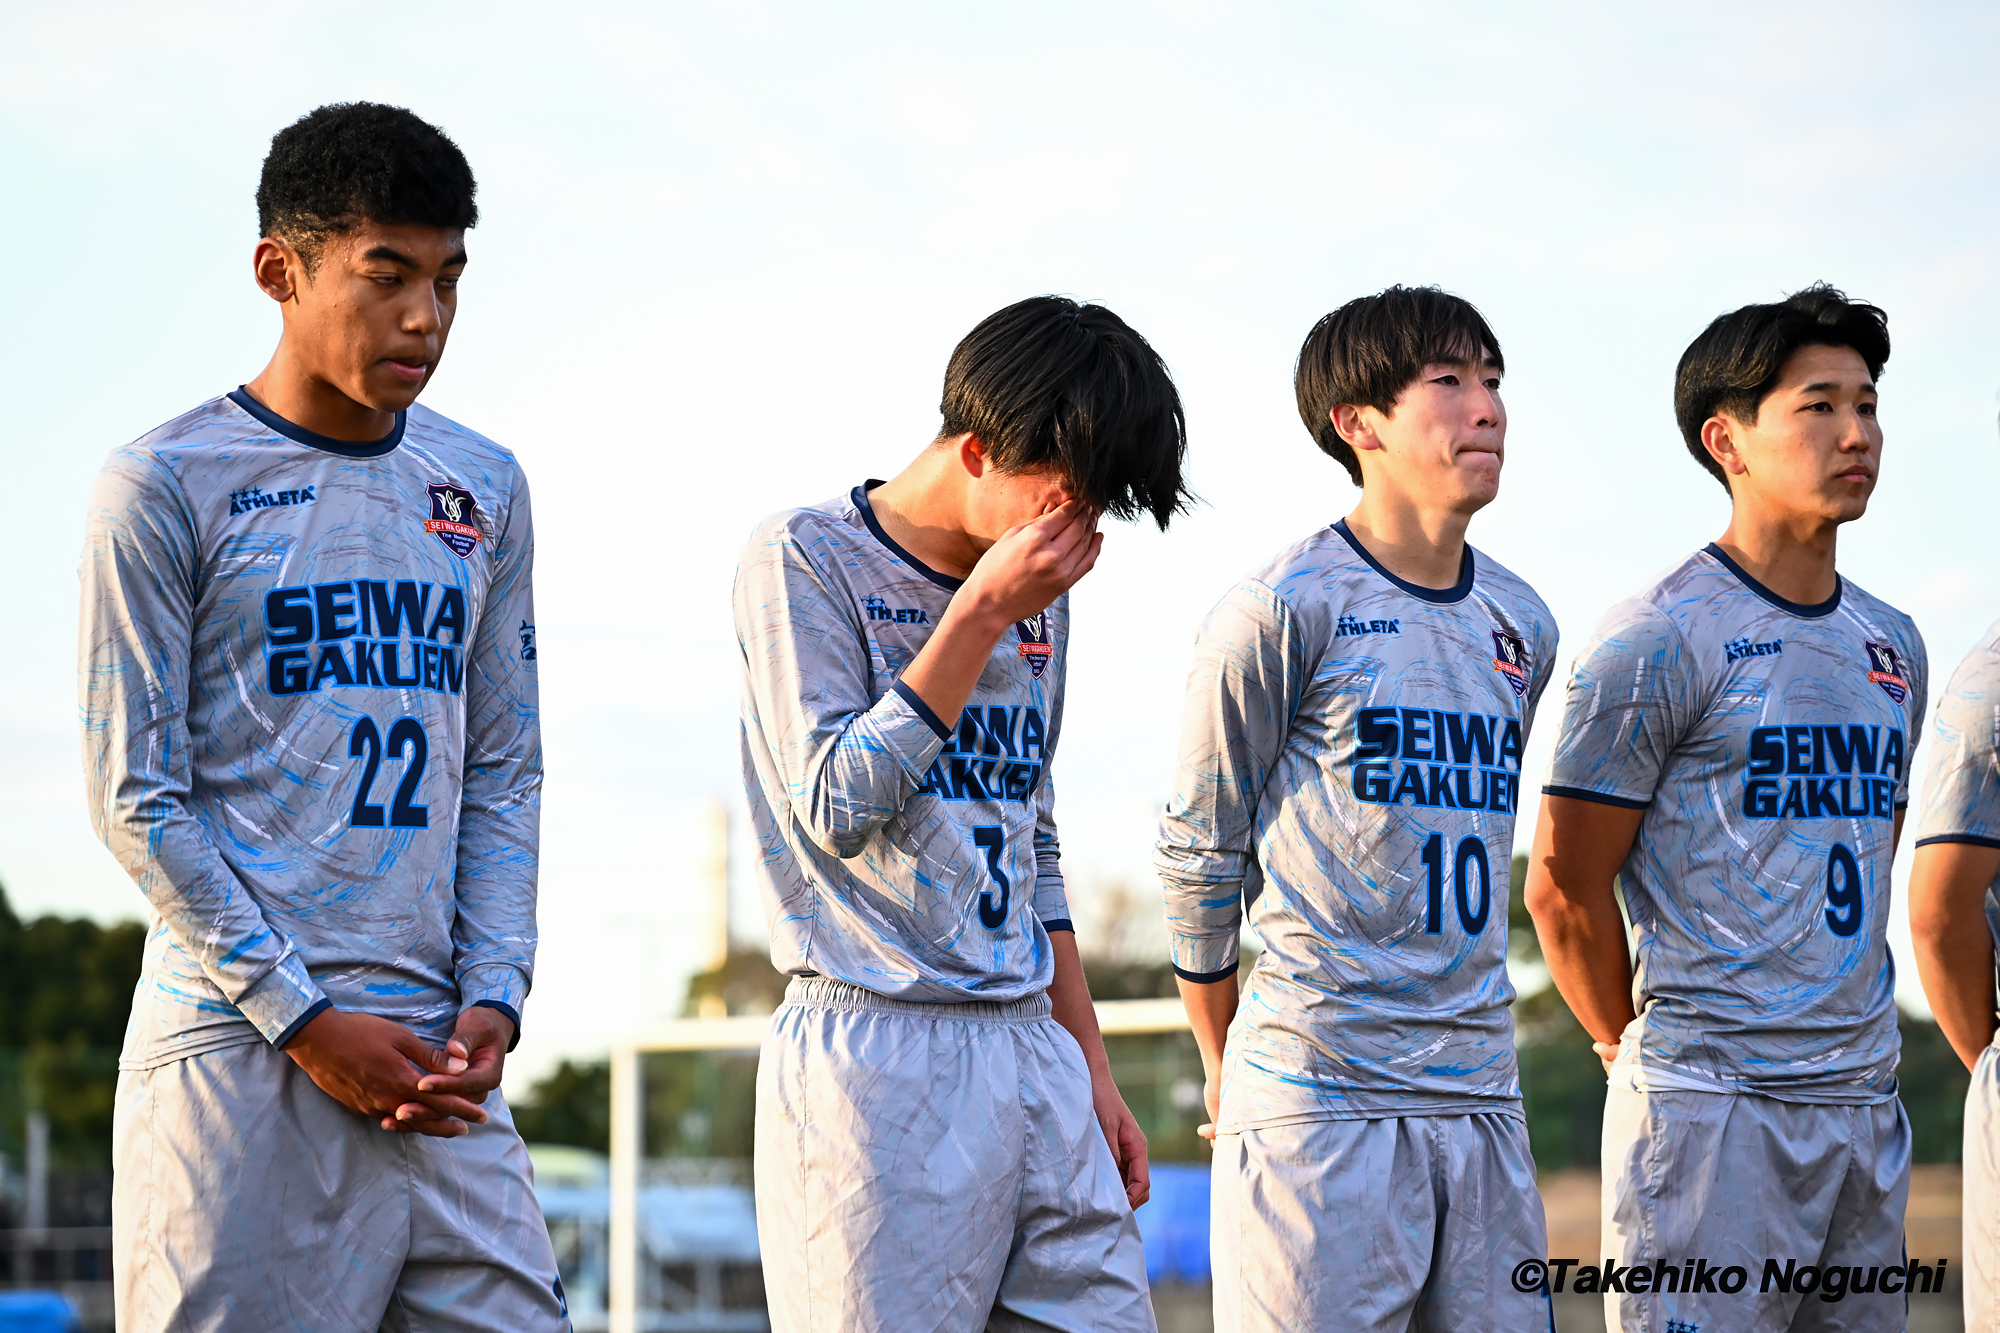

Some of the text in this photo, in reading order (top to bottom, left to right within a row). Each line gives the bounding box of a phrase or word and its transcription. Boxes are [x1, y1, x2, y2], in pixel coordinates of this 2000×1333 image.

[229, 488, 317, 517] ATHLETA
[431, 521, 479, 537] SEIWA GAKUEN
[265, 578, 465, 646] SEIWA
[866, 606, 931, 624] THETA
[267, 640, 466, 697] GAKUEN
[1726, 641, 1782, 664] ATHLETA
[941, 705, 1046, 760] IWA
[1355, 706, 1522, 772] SEIWA
[1750, 724, 1904, 780] SEIWA
[348, 714, 429, 829] 22
[973, 825, 1010, 930] 3
[1420, 831, 1491, 937] 10
[1824, 842, 1864, 938] 9
